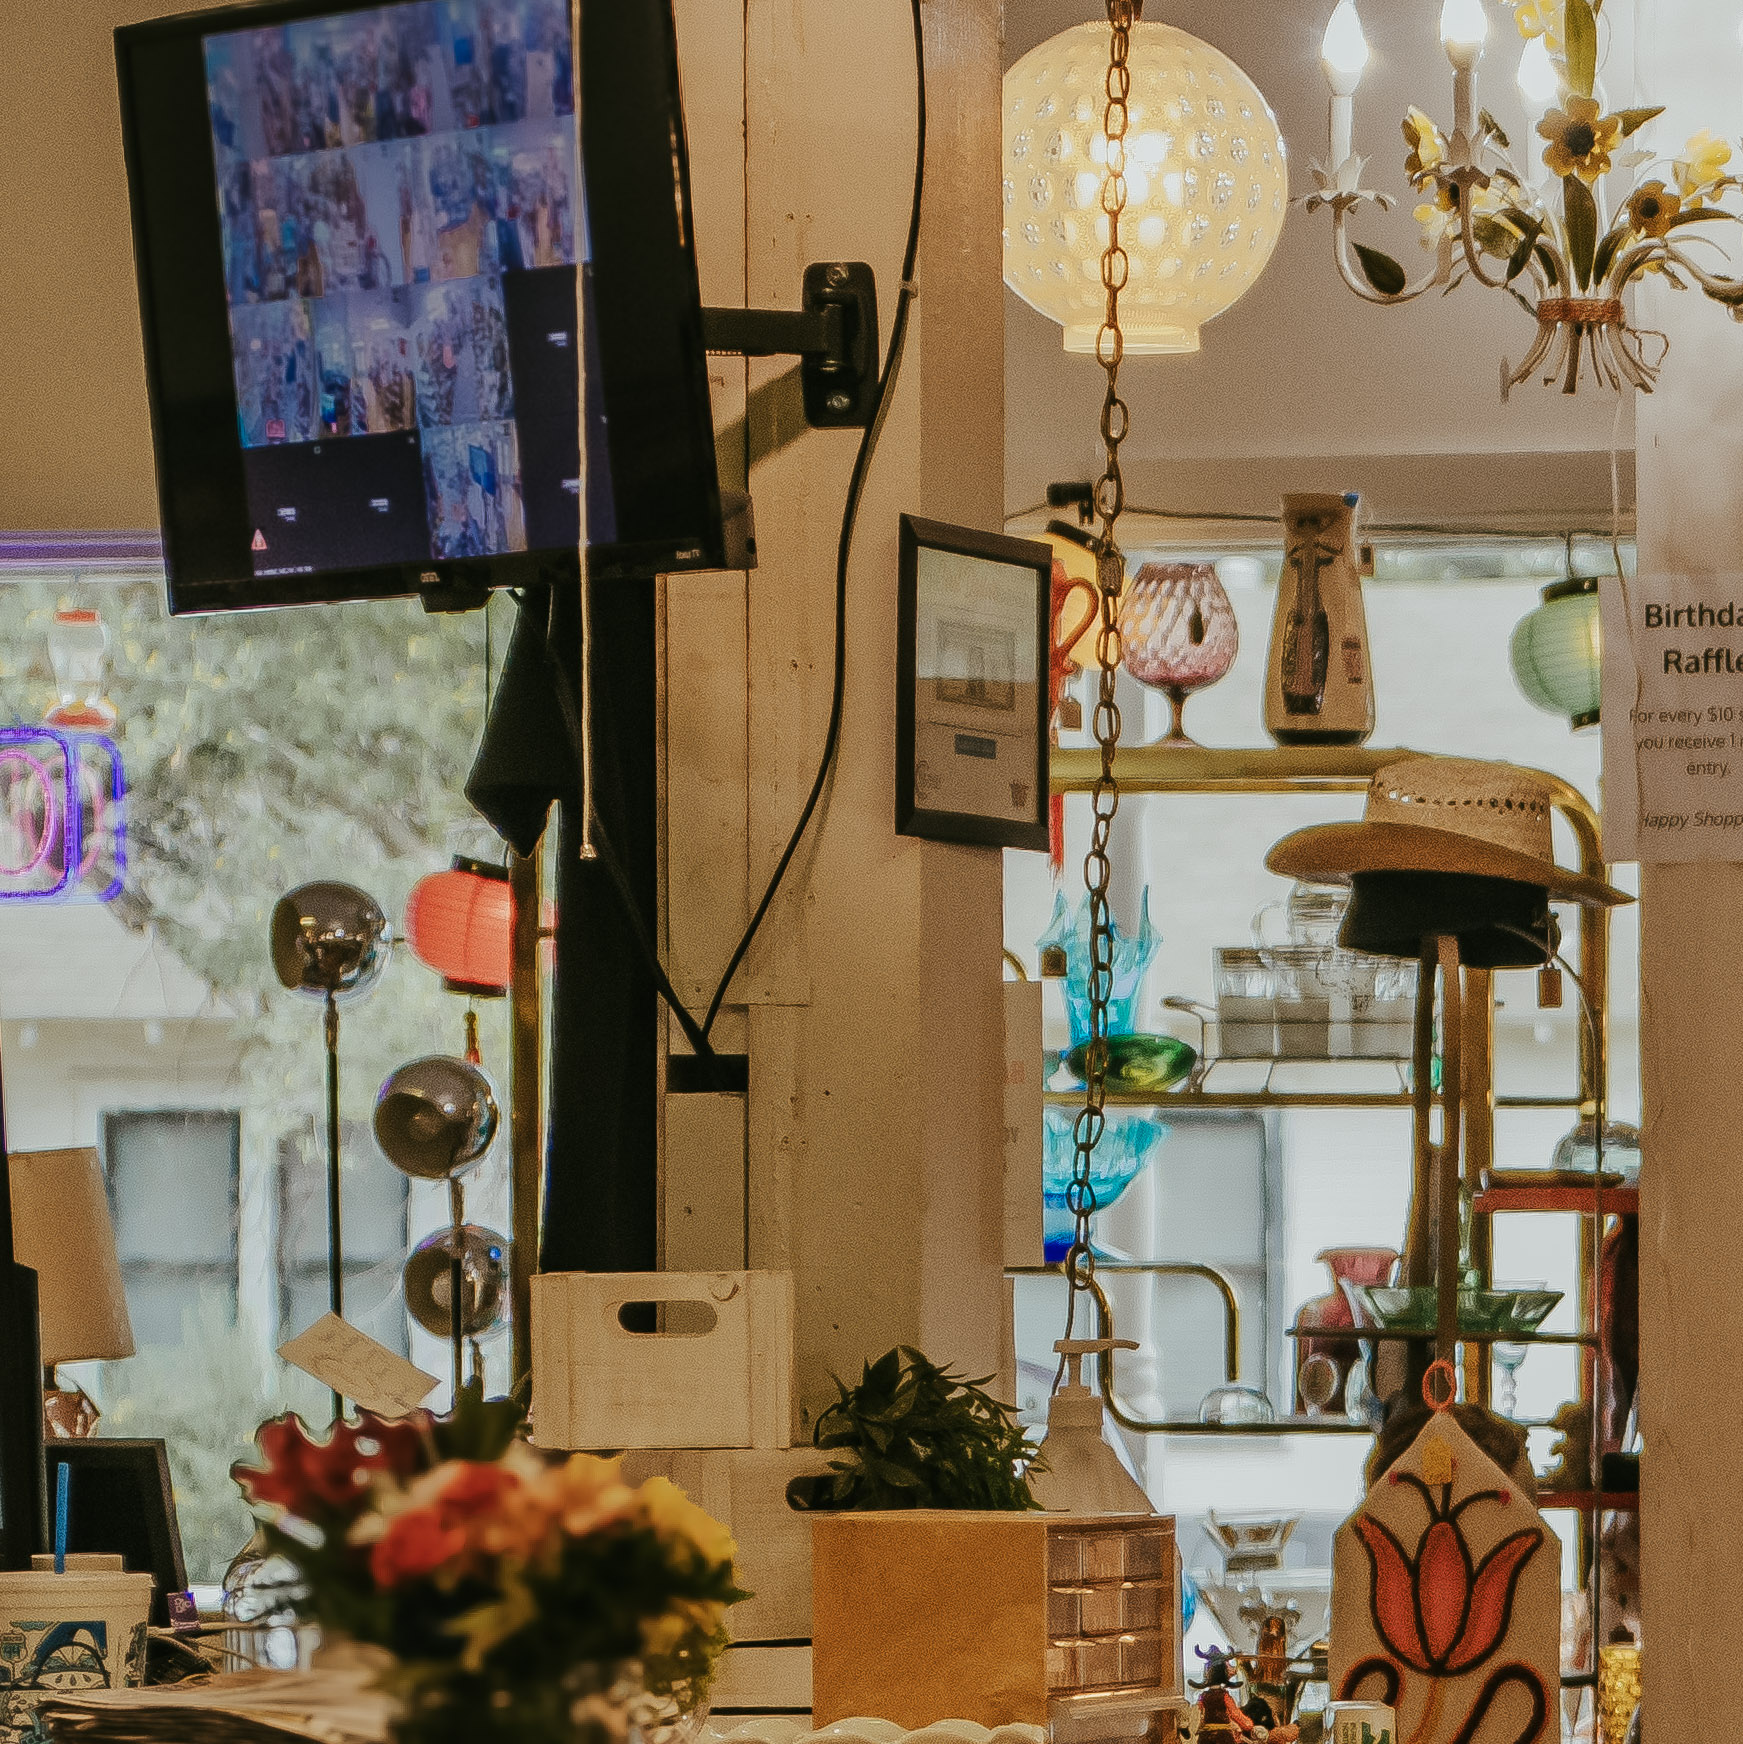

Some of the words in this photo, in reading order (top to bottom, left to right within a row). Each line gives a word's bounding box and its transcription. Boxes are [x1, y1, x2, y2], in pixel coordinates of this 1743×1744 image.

[1629, 708, 1654, 724] For
[1658, 710, 1702, 727] every
[1707, 706, 1734, 723] $10
[1635, 737, 1664, 751] you
[1668, 735, 1726, 750] receive
